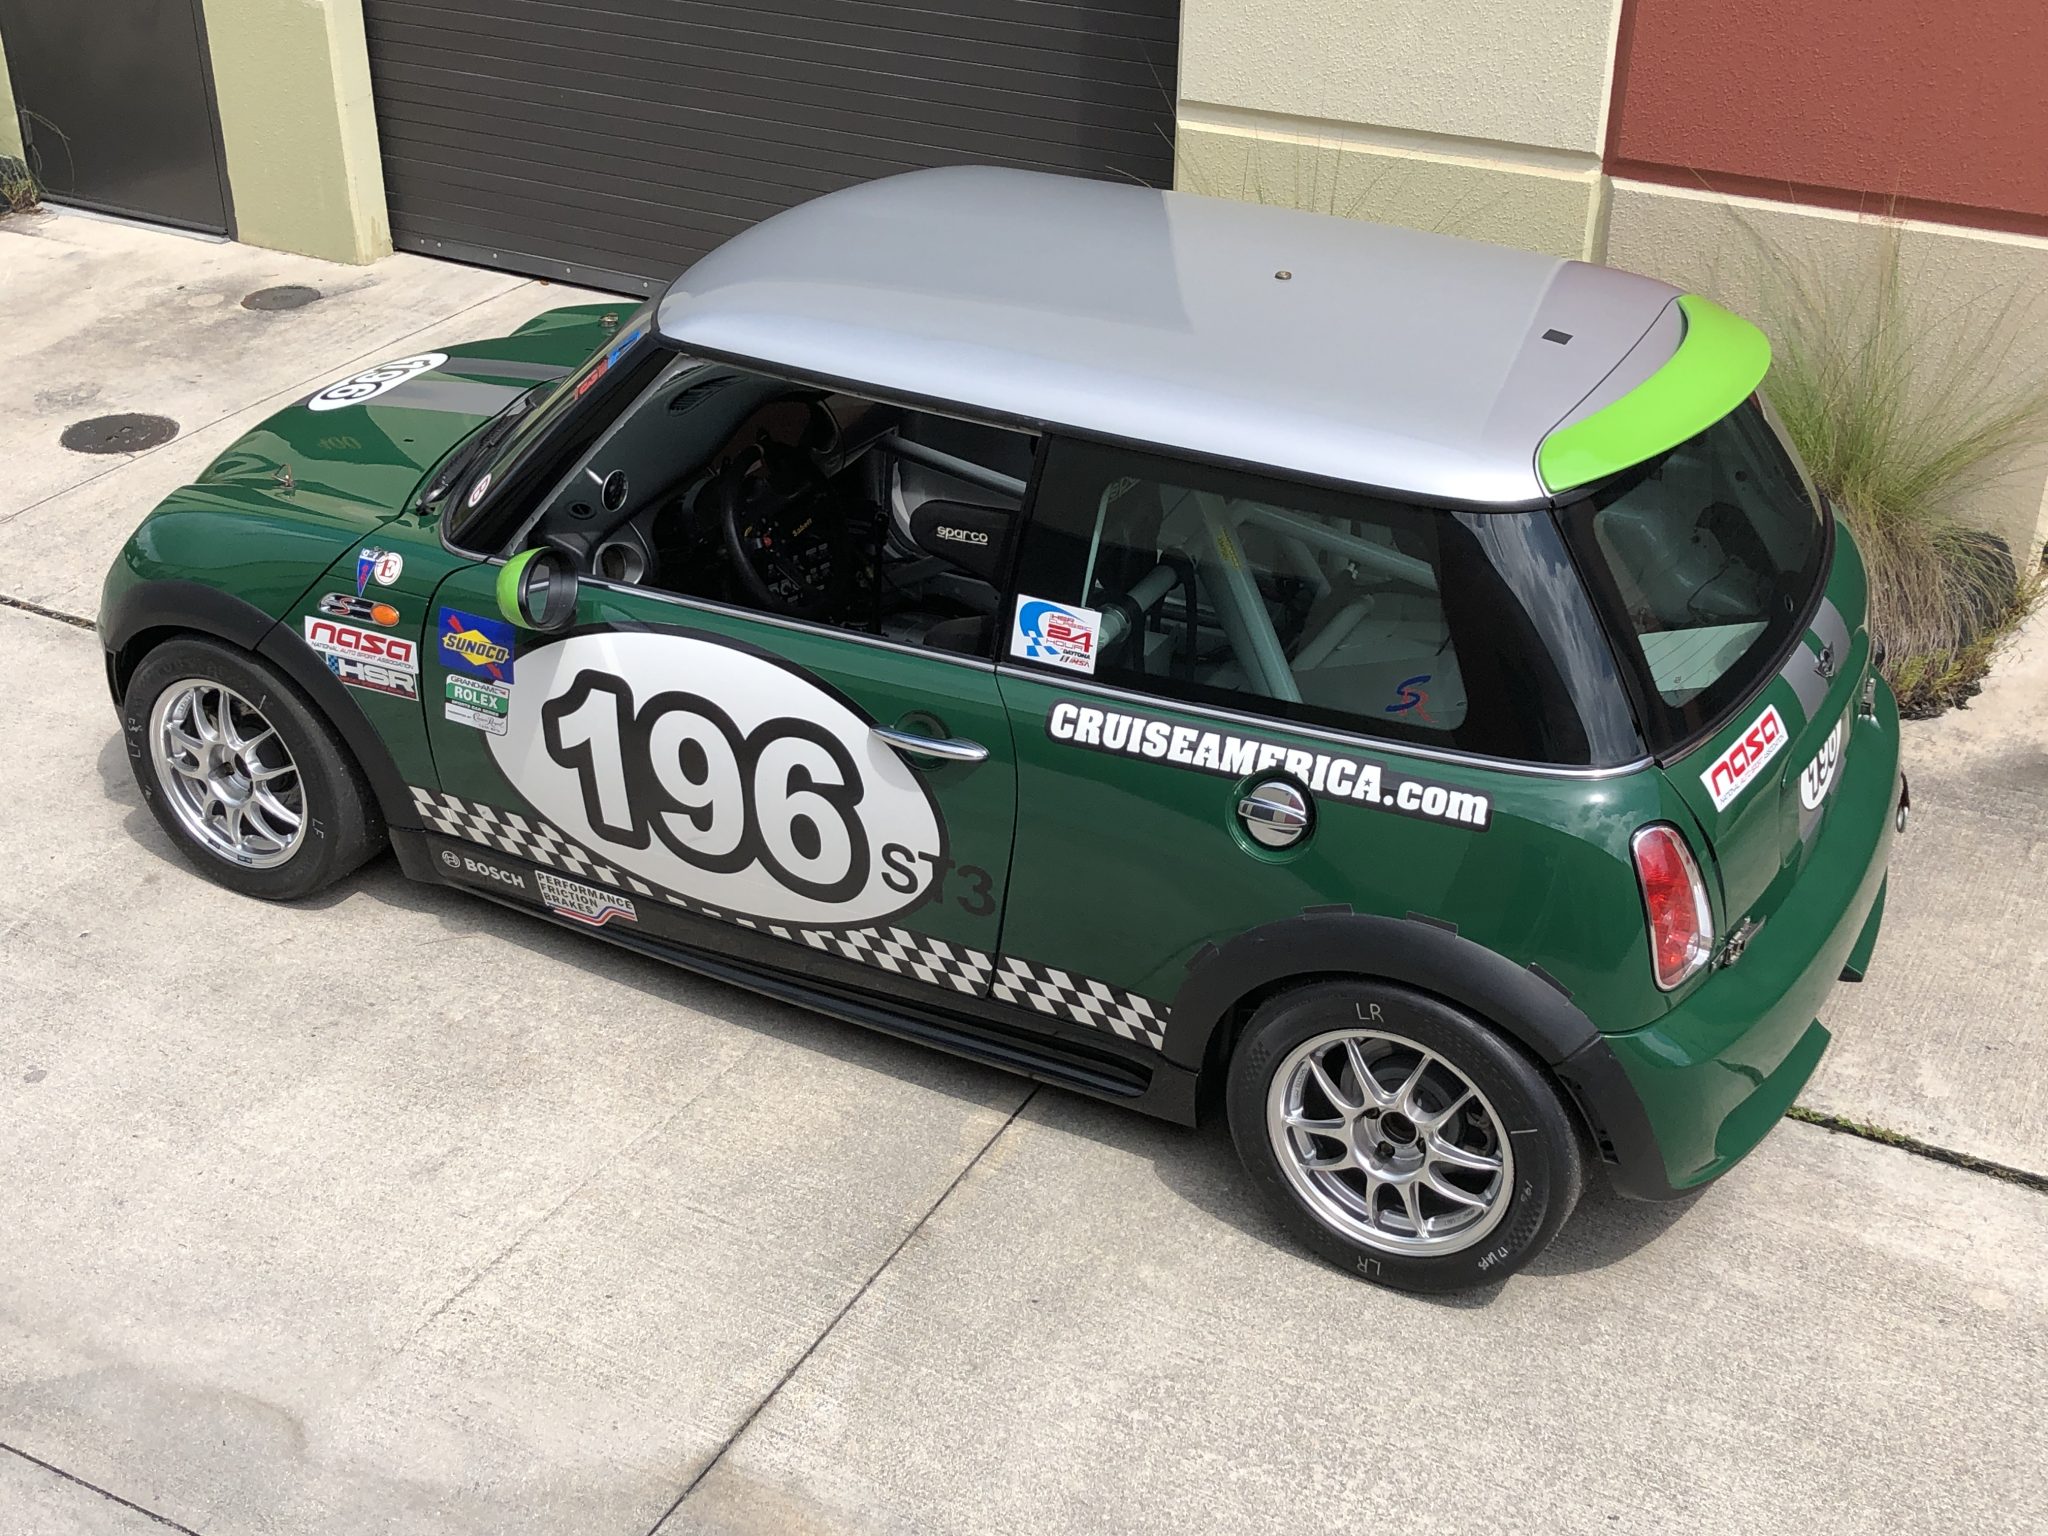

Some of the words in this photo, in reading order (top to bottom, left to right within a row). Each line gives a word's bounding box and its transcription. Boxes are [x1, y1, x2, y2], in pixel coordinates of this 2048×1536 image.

[936, 524, 989, 544] sparco
[379, 559, 397, 578] E
[445, 633, 509, 664] SUNOCO
[1046, 638, 1083, 651] HOUR
[1047, 624, 1094, 653] 24
[1062, 649, 1091, 659] DAYTONA
[337, 658, 414, 692] HSR
[454, 686, 499, 709] ROLEX
[544, 672, 870, 902] 196
[312, 816, 324, 839] LF
[463, 857, 526, 889] BOSCH
[881, 843, 996, 917] ST3
[537, 873, 633, 910] PERFORMANCE
[540, 882, 598, 908] FRICTION
[543, 893, 594, 915] BRAKES
[1355, 1002, 1384, 1023] LR
[1356, 1255, 1381, 1276] LR
